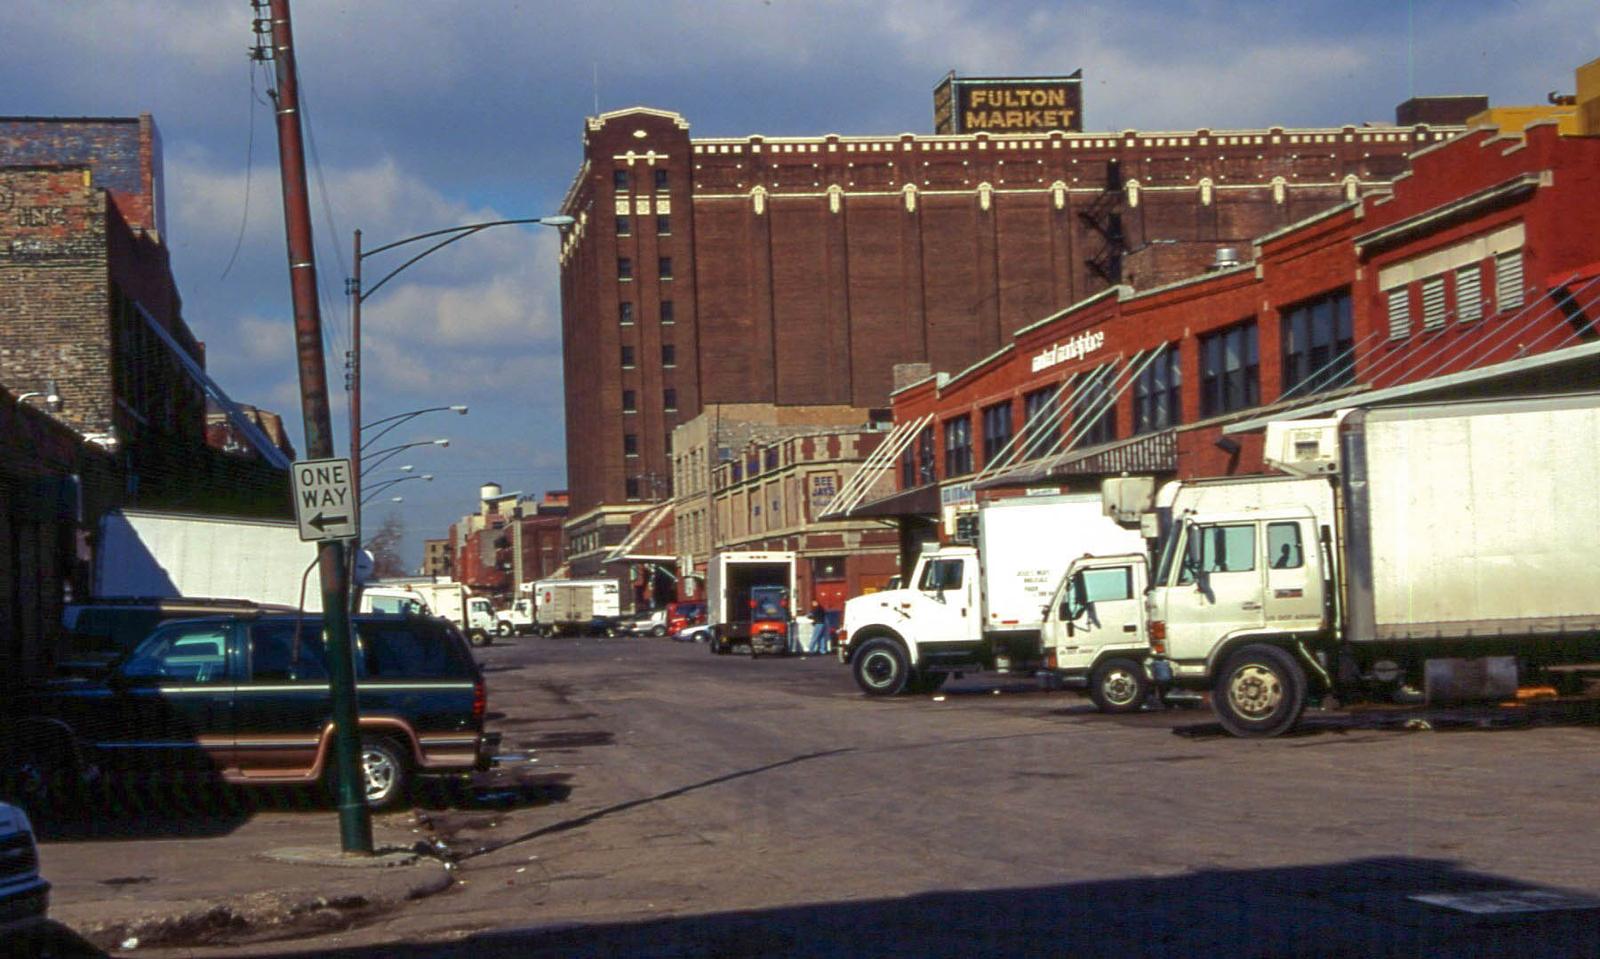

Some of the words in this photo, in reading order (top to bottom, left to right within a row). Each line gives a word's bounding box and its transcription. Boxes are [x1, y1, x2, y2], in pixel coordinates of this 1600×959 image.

[970, 88, 1066, 108] FULTON
[965, 109, 1074, 128] MARKET
[301, 465, 346, 487] ONE
[302, 487, 347, 509] WAY
